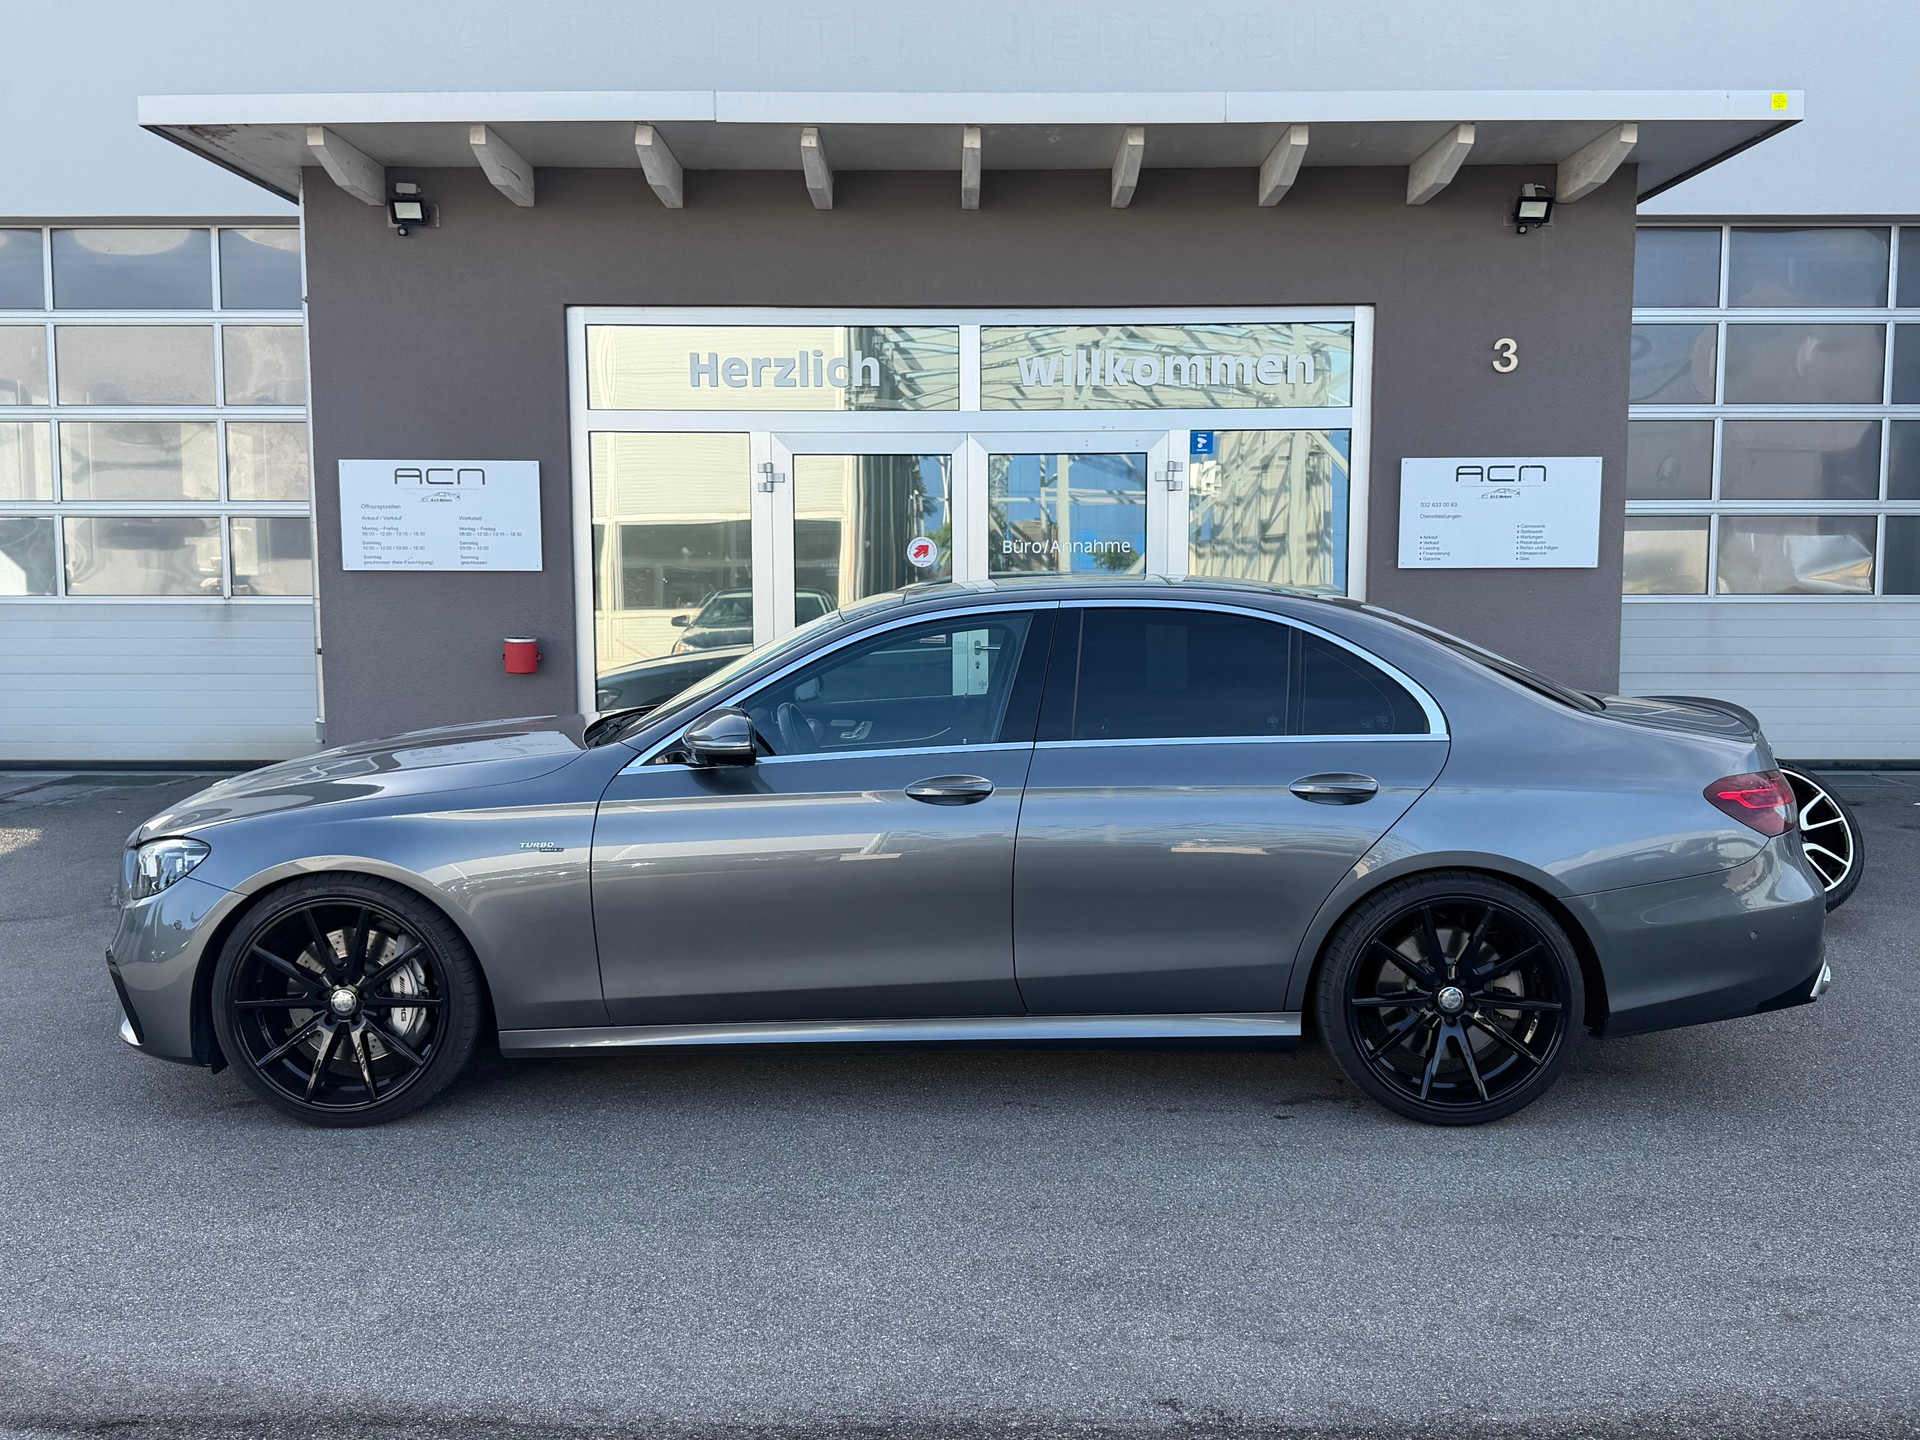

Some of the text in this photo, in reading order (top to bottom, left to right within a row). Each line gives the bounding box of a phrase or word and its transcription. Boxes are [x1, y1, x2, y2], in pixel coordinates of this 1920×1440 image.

[1492, 337, 1519, 373] 3
[689, 348, 1315, 388] Herzlich willkommen
[394, 467, 486, 485] ACN
[1455, 465, 1547, 482] ACN
[361, 503, 401, 511] Öffnungszeiten
[1002, 539, 1131, 554] Büro/Annahme
